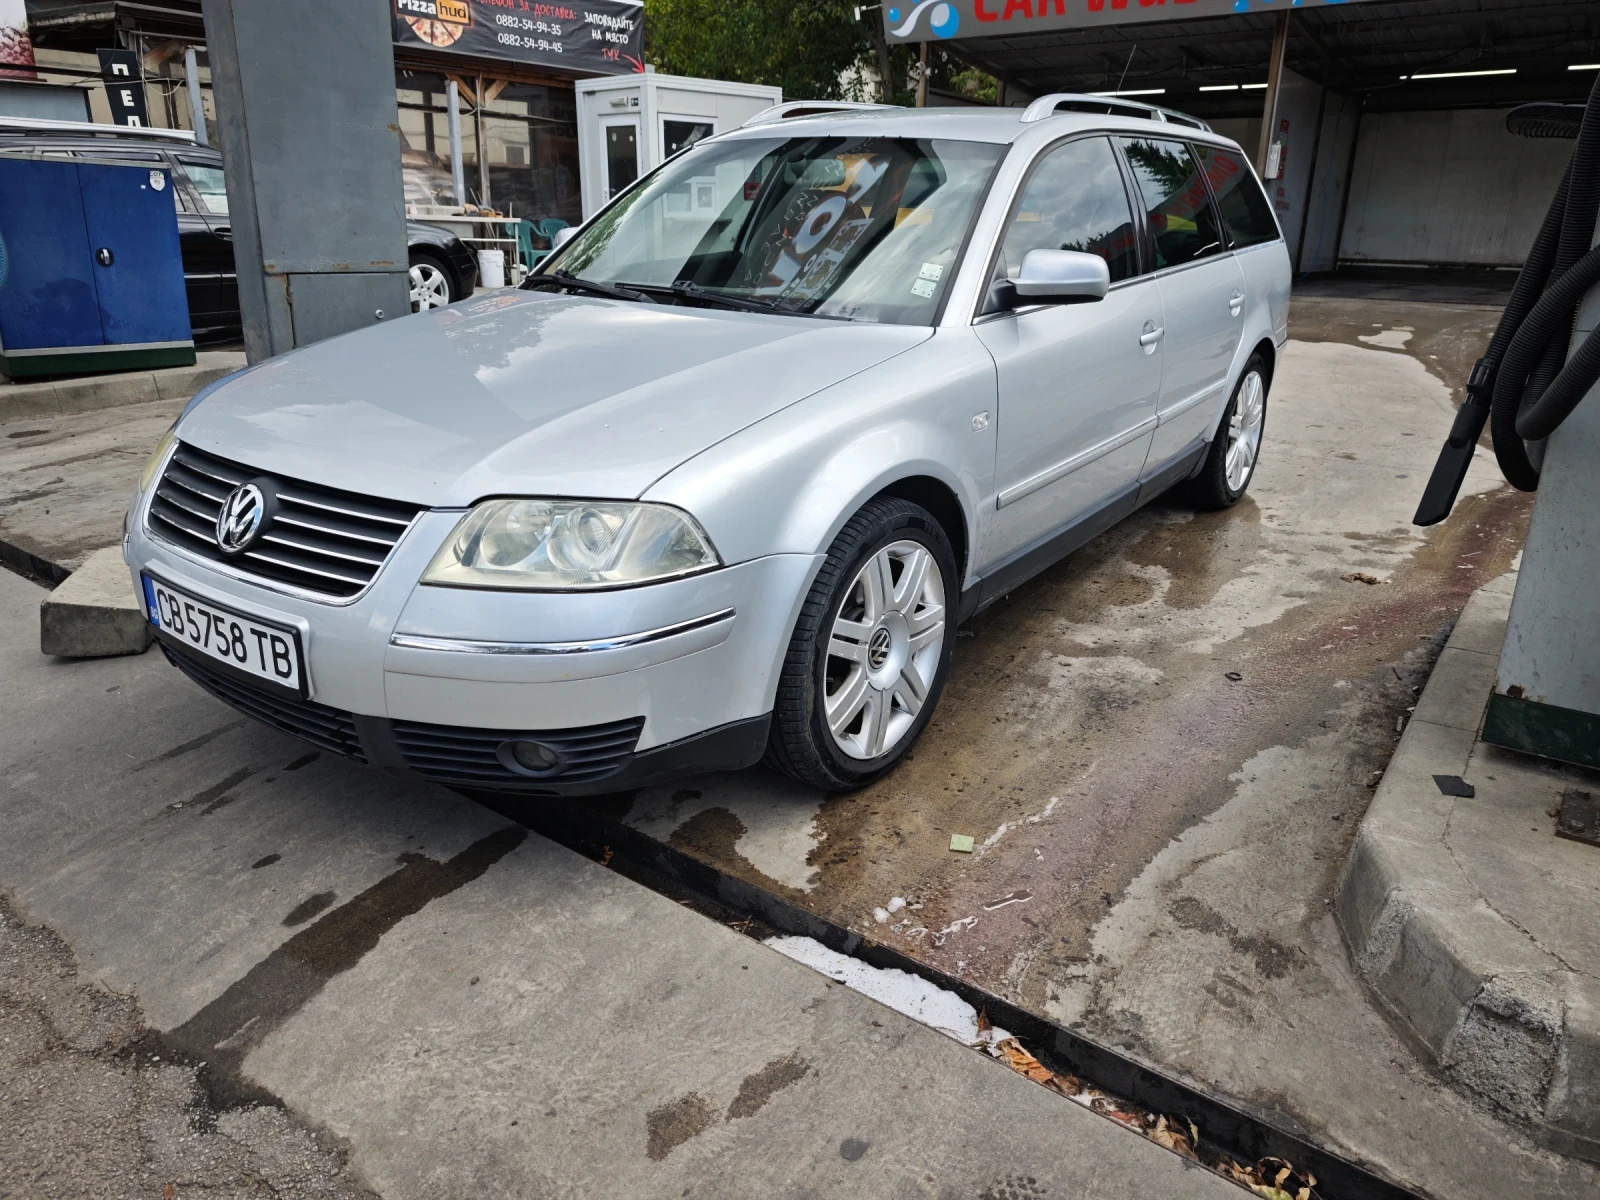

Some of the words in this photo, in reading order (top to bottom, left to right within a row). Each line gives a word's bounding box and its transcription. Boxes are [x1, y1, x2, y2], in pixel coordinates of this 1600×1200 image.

[440, 2, 466, 18] hud
[496, 14, 562, 36] 0882-54-94-35
[498, 33, 563, 53] 0882-54-94-45
[592, 29, 602, 40] НА
[606, 31, 629, 44] МЯСТО
